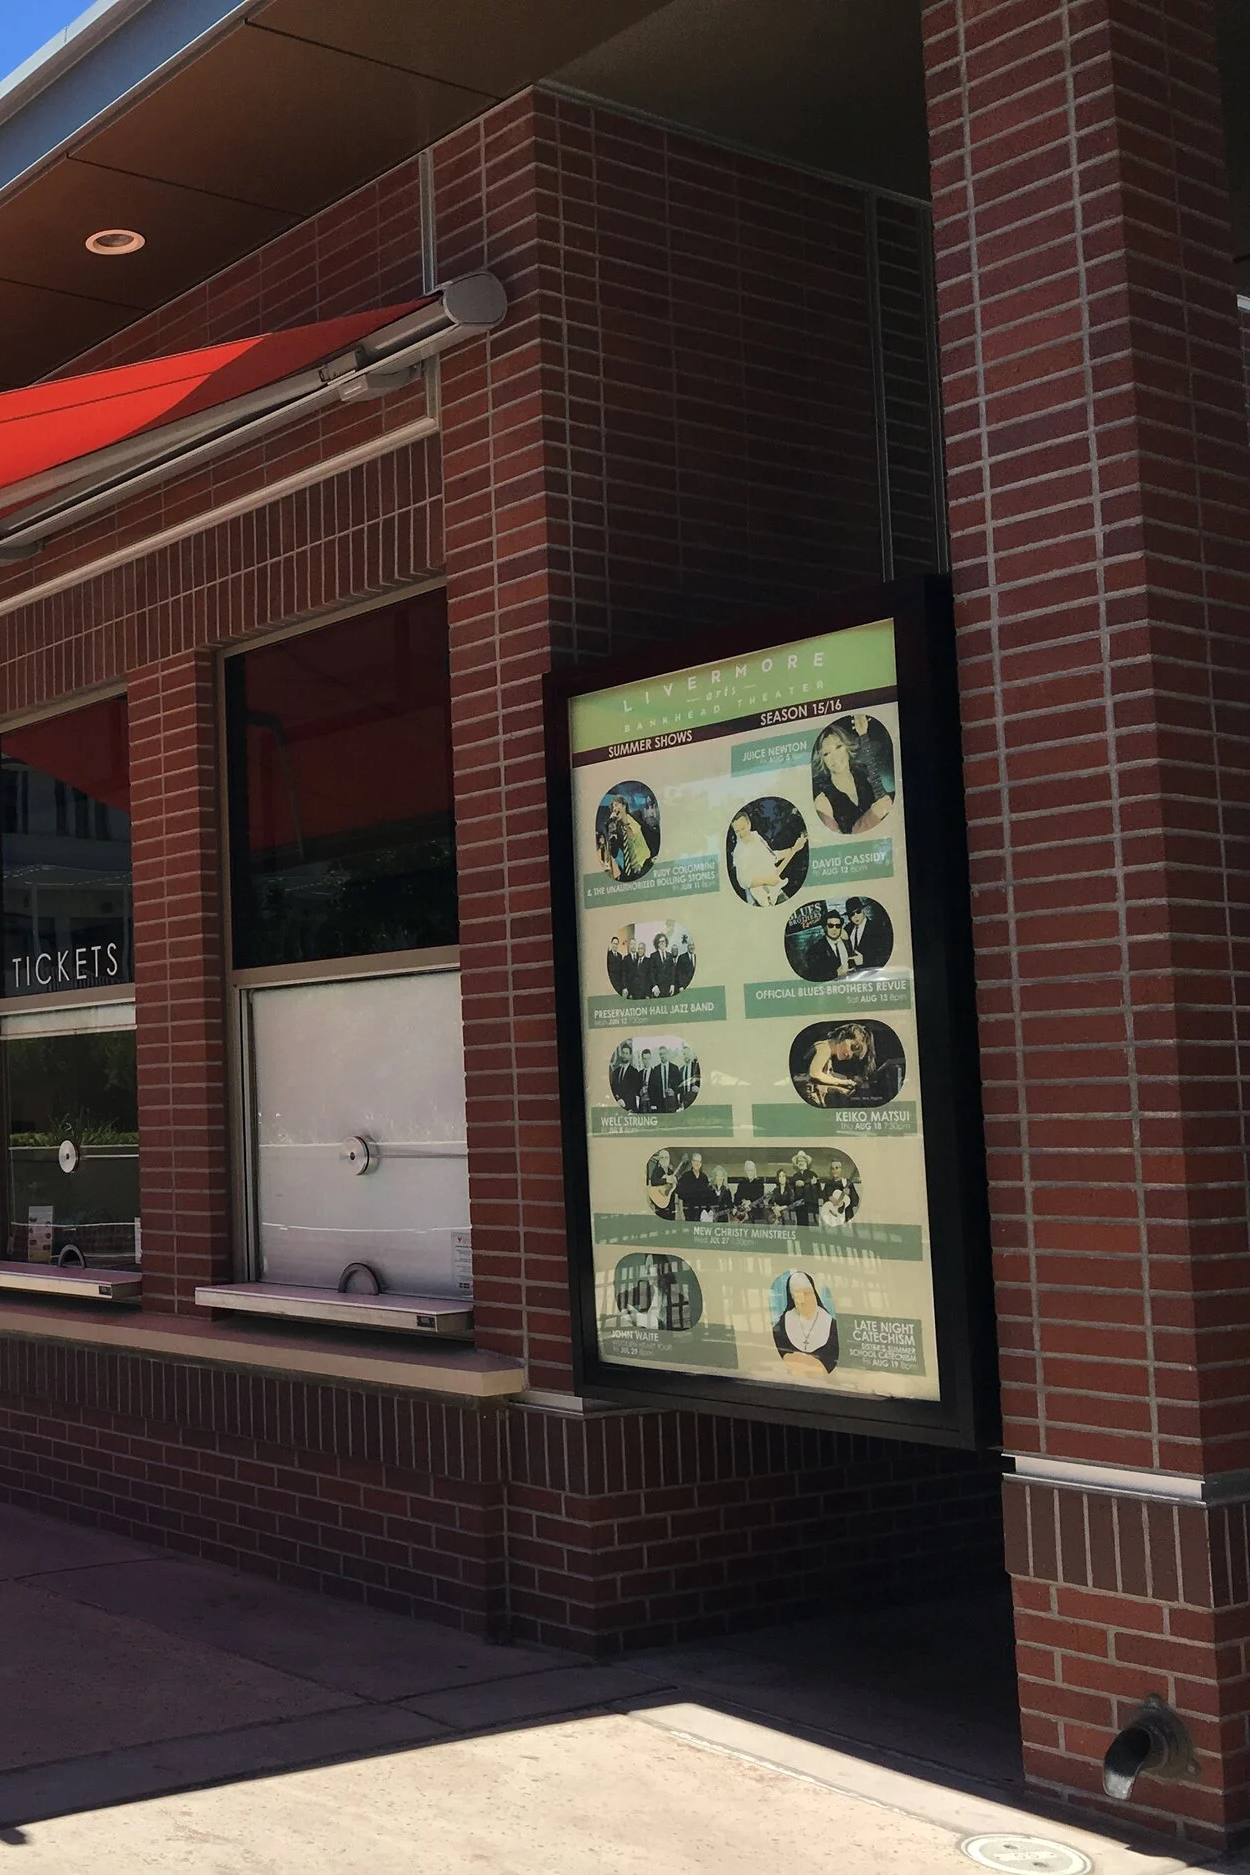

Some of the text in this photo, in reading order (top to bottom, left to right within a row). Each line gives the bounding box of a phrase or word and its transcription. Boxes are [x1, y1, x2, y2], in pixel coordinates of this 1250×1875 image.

[623, 652, 825, 713] LIVERMORE
[705, 685, 736, 702] arts
[623, 680, 825, 733] BANKHEAD THEATER
[760, 699, 842, 726] SEASON 15/16
[608, 730, 693, 758] SUMMER SHOWS
[742, 748, 766, 762] JUICE
[768, 740, 807, 756] NEWTON
[812, 851, 887, 870] DAVID CASSIDY
[653, 868, 671, 878] RUDY
[821, 867, 839, 876] AUG
[593, 886, 606, 896] THE
[607, 880, 655, 894] UNAUTHORIZED
[656, 876, 687, 887] ROLLING
[688, 871, 716, 882] STONES
[12, 942, 118, 988] TICKETS
[755, 980, 907, 1000] OFFICIAL BLUES BROTHERS REVUE
[860, 994, 878, 1003] AUG
[594, 1002, 715, 1019] PRESERVATION HALL JAZZ BAND
[600, 1116, 659, 1126] WELL STRUNG
[835, 1110, 910, 1122] KEIKO MATSUI
[854, 1122, 871, 1130] AUG
[874, 1122, 882, 1130] 18
[693, 1226, 797, 1240] NEW CHRISTY MINSTRELS
[854, 1319, 915, 1335] LATE NIGHT
[611, 1329, 659, 1342] JOHN WAITE
[852, 1330, 916, 1346] CATECHISM
[872, 1358, 890, 1368] AUG
[891, 1360, 900, 1368] 19
